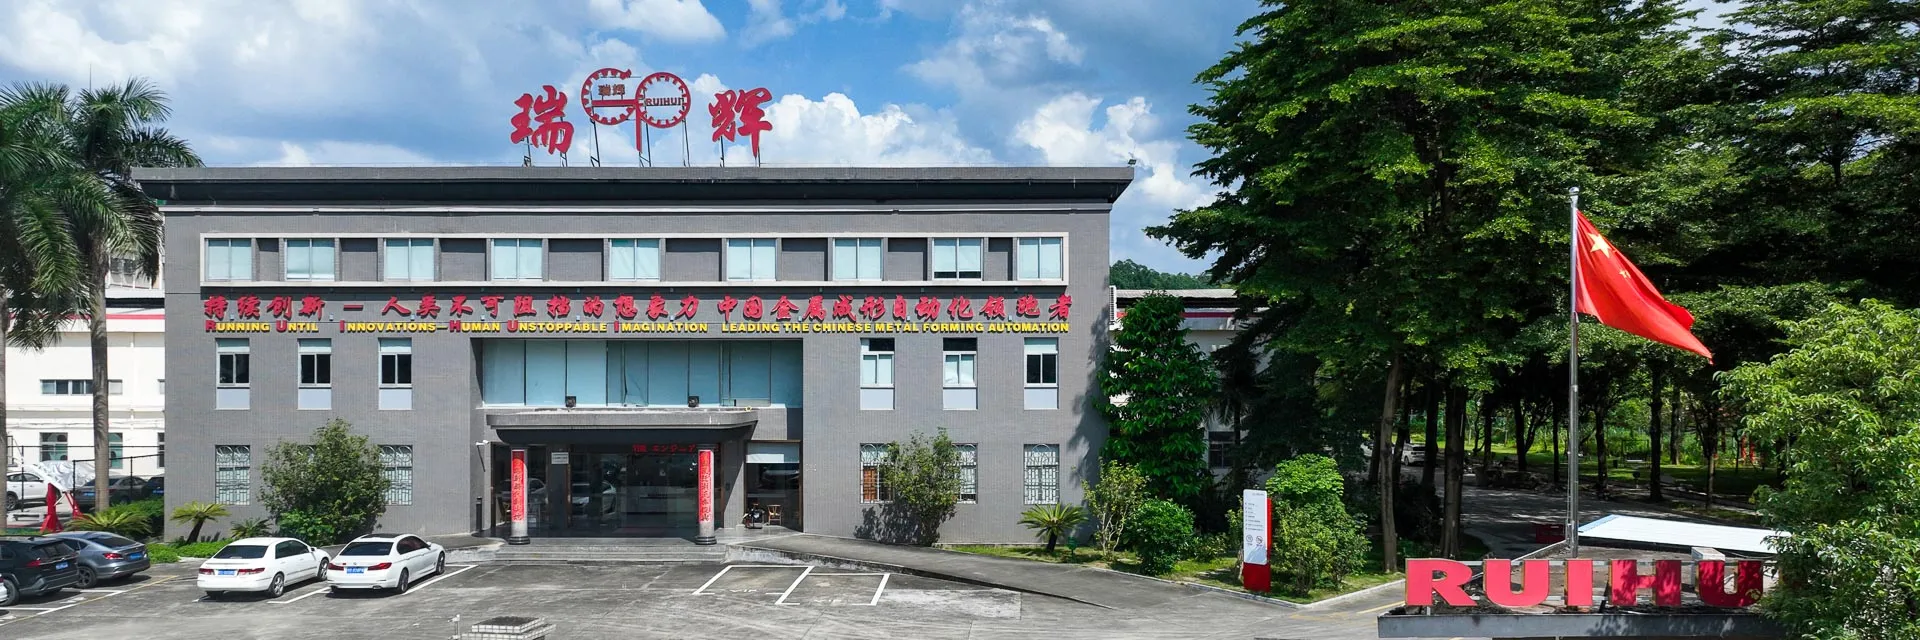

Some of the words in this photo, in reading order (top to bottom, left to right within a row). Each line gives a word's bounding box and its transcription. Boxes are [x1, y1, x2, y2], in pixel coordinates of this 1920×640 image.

[510, 85, 574, 154] 瑞
[205, 320, 270, 332] RUNNING
[276, 320, 319, 332] UNTIL
[507, 320, 608, 332] UNSTOPPABLE
[613, 320, 708, 332] IMAGINATION
[721, 322, 780, 333] LEADING
[783, 322, 810, 333] THE
[816, 322, 872, 333] CHINESE
[874, 322, 919, 333] METAL
[922, 322, 985, 333] FORMING
[988, 322, 1070, 333] AUTOMATION
[1405, 558, 1788, 608] RUIHU
